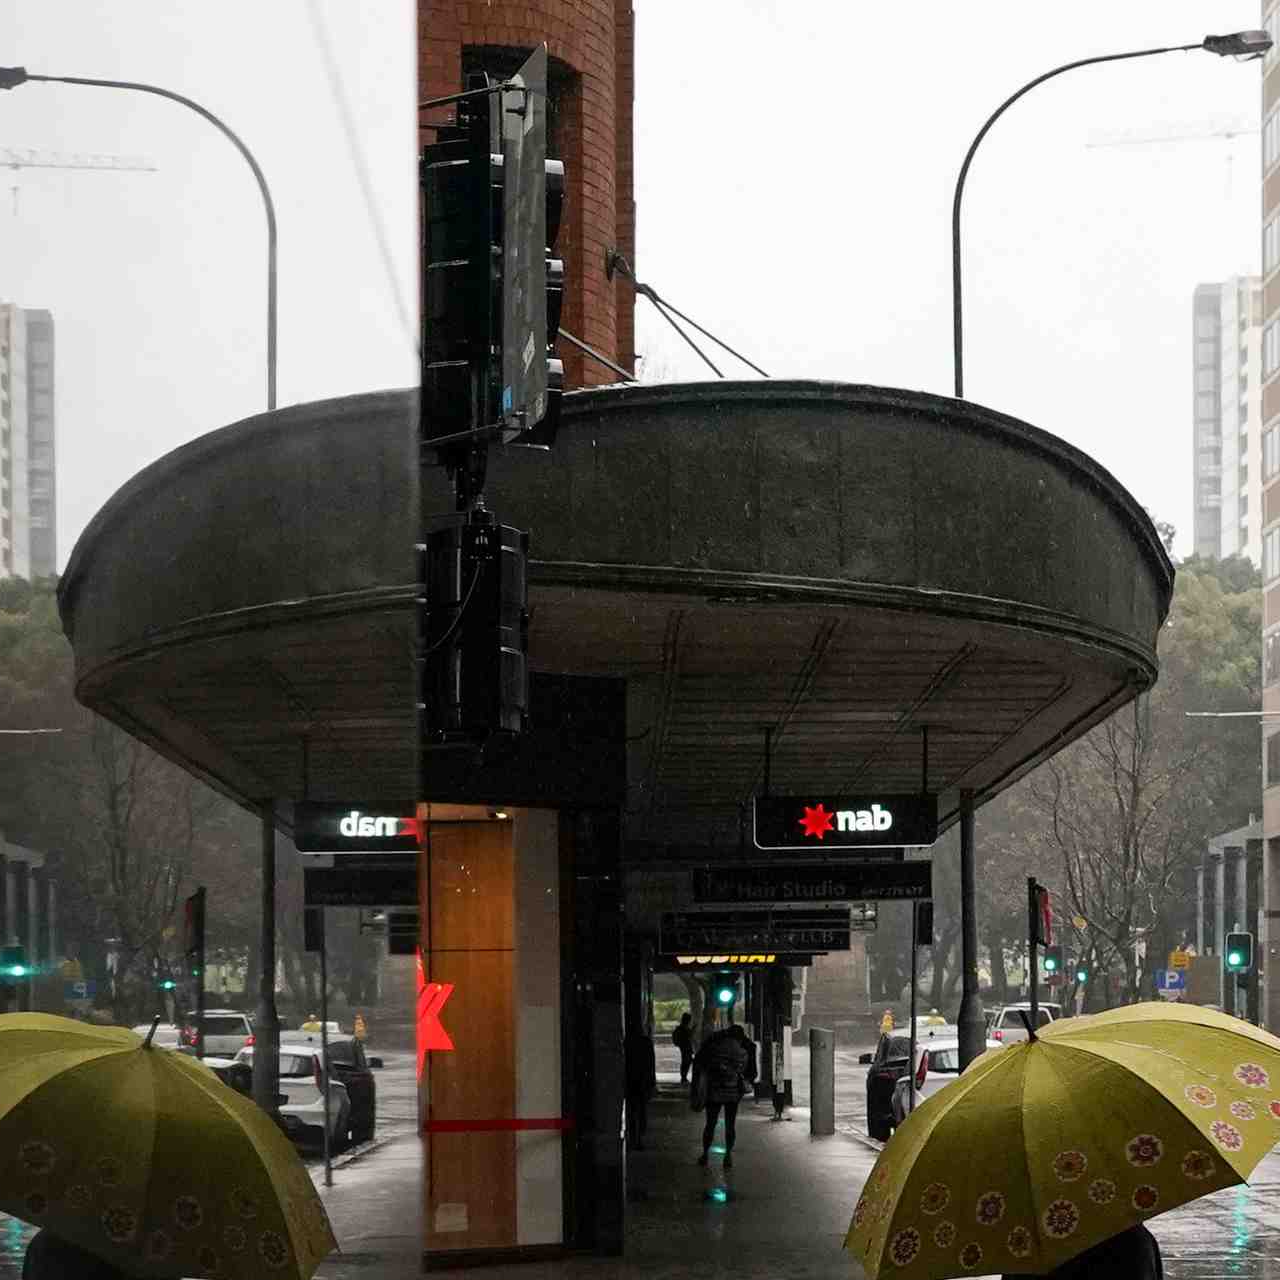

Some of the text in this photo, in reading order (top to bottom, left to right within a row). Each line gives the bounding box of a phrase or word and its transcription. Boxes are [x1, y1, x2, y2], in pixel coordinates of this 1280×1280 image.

[836, 804, 892, 831] nab
[783, 879, 847, 898] Studio
[1166, 971, 1180, 988] P
